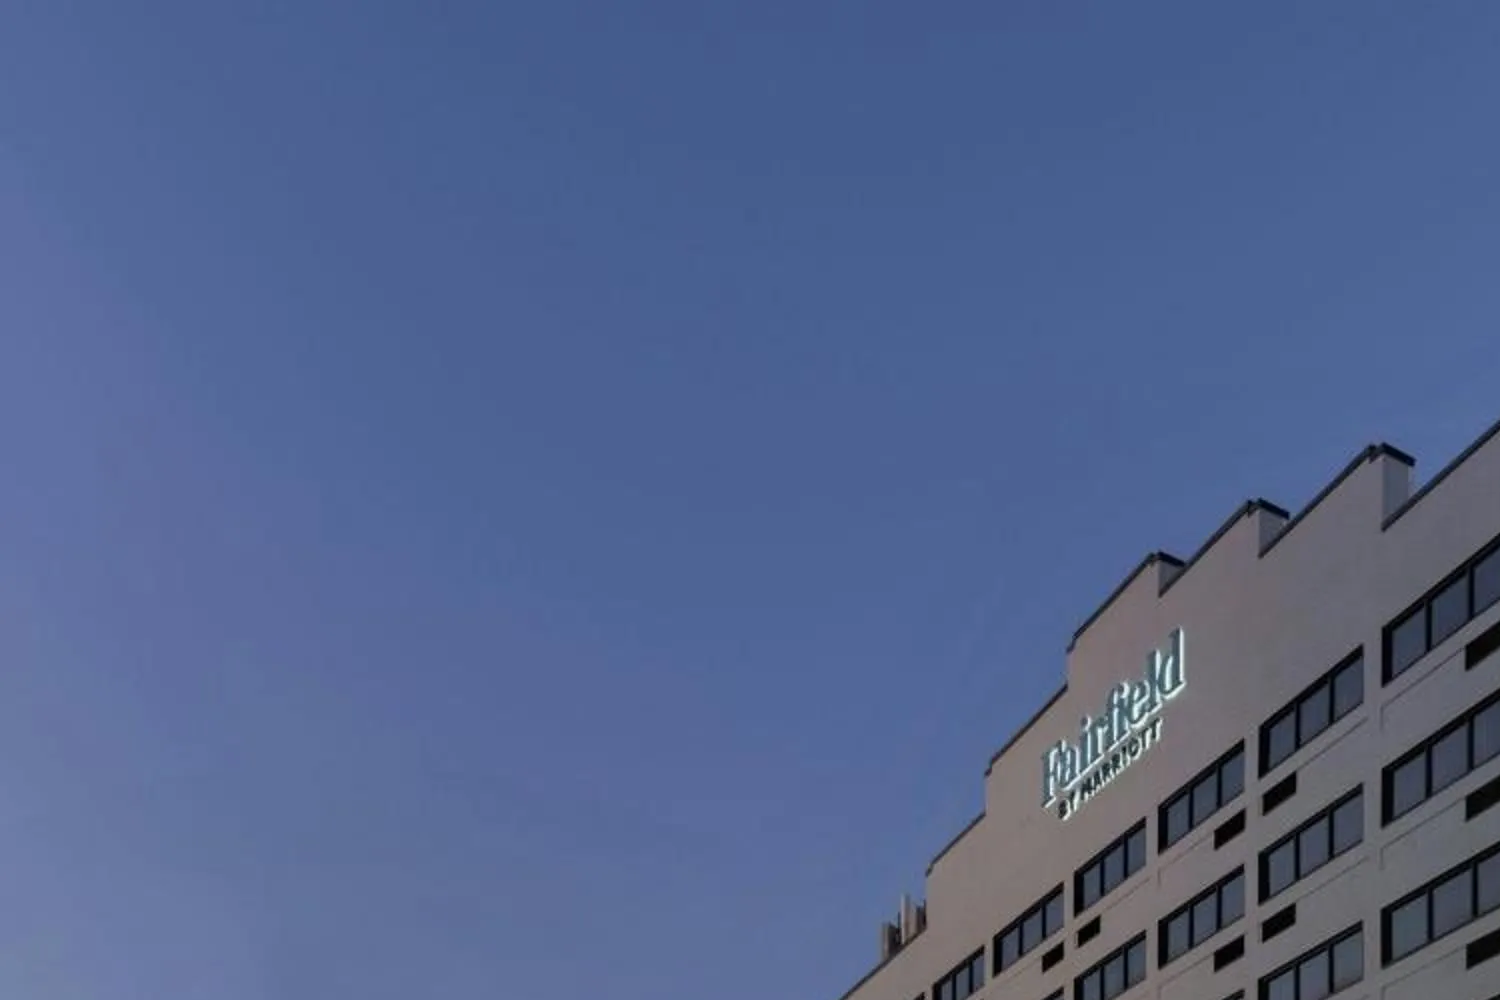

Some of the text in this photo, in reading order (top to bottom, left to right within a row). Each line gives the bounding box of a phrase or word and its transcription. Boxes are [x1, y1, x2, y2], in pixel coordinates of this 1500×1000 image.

[1041, 625, 1187, 808] Fairfield
[1058, 717, 1164, 821] BY MARRIOTT
